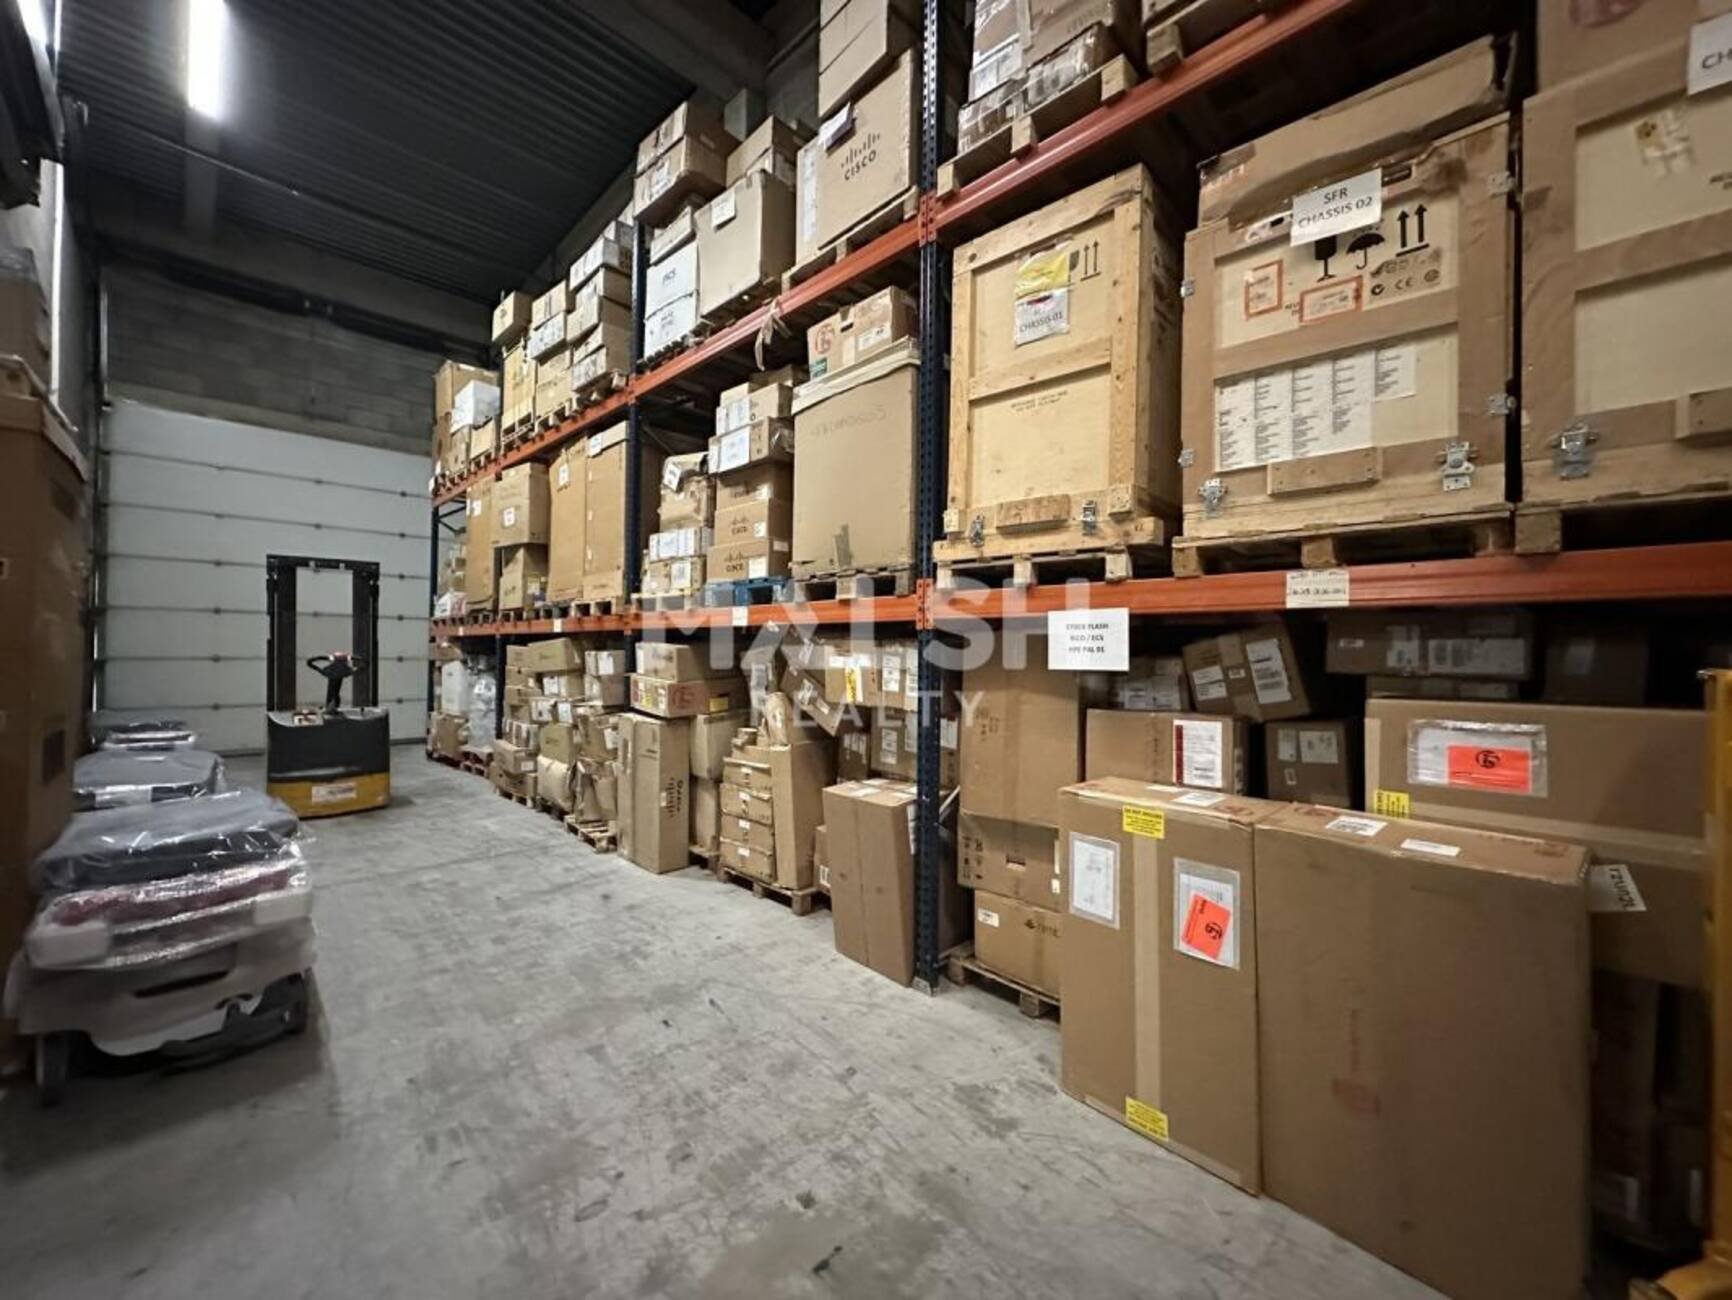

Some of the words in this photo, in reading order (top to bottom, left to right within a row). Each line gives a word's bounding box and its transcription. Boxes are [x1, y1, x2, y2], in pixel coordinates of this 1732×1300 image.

[1323, 187, 1348, 204] SFR
[1298, 202, 1353, 228] CHASSIS
[1355, 196, 1373, 210] 02
